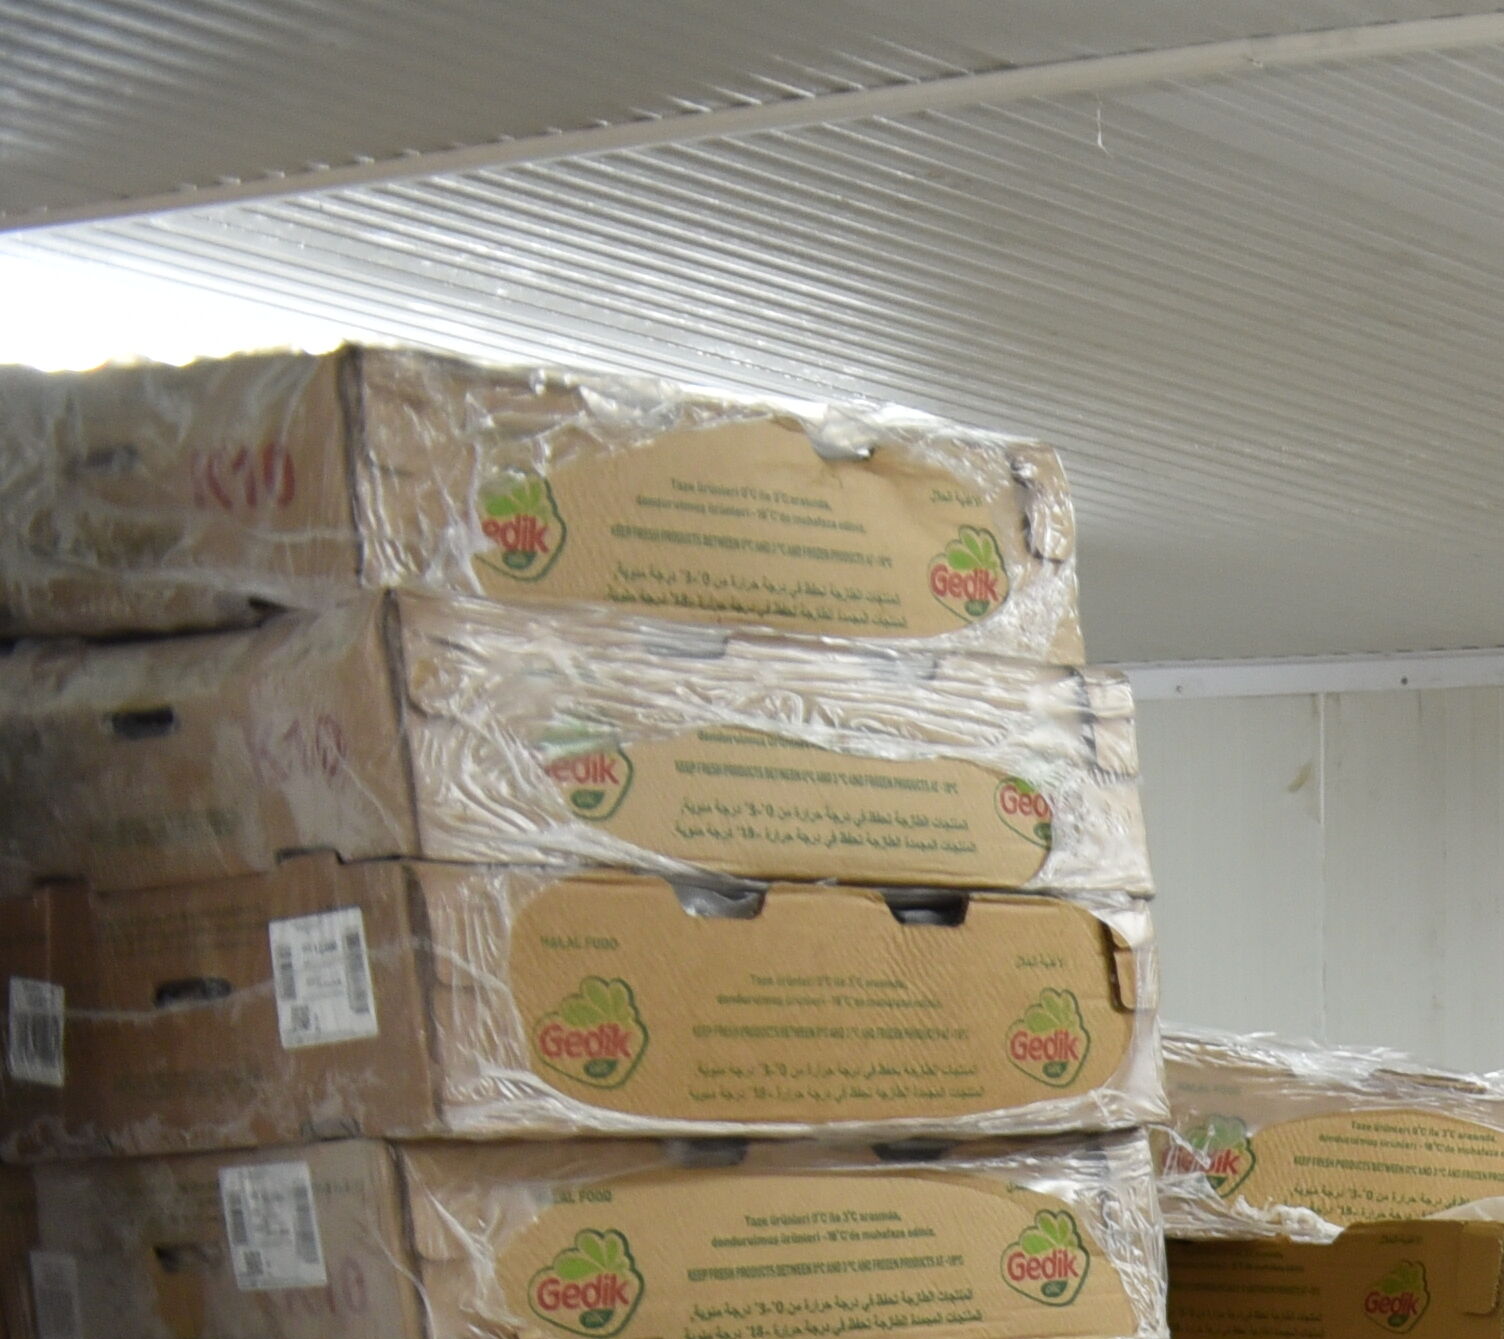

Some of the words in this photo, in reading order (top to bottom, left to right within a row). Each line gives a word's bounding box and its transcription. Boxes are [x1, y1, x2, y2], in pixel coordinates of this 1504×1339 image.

[930, 563, 998, 602] Gedik
[539, 1022, 632, 1063] Gedik
[1010, 1030, 1080, 1065] Gedik
[1008, 1249, 1078, 1284] Gedik
[537, 1273, 630, 1313] Gedik
[1364, 1288, 1420, 1318] Gedik
